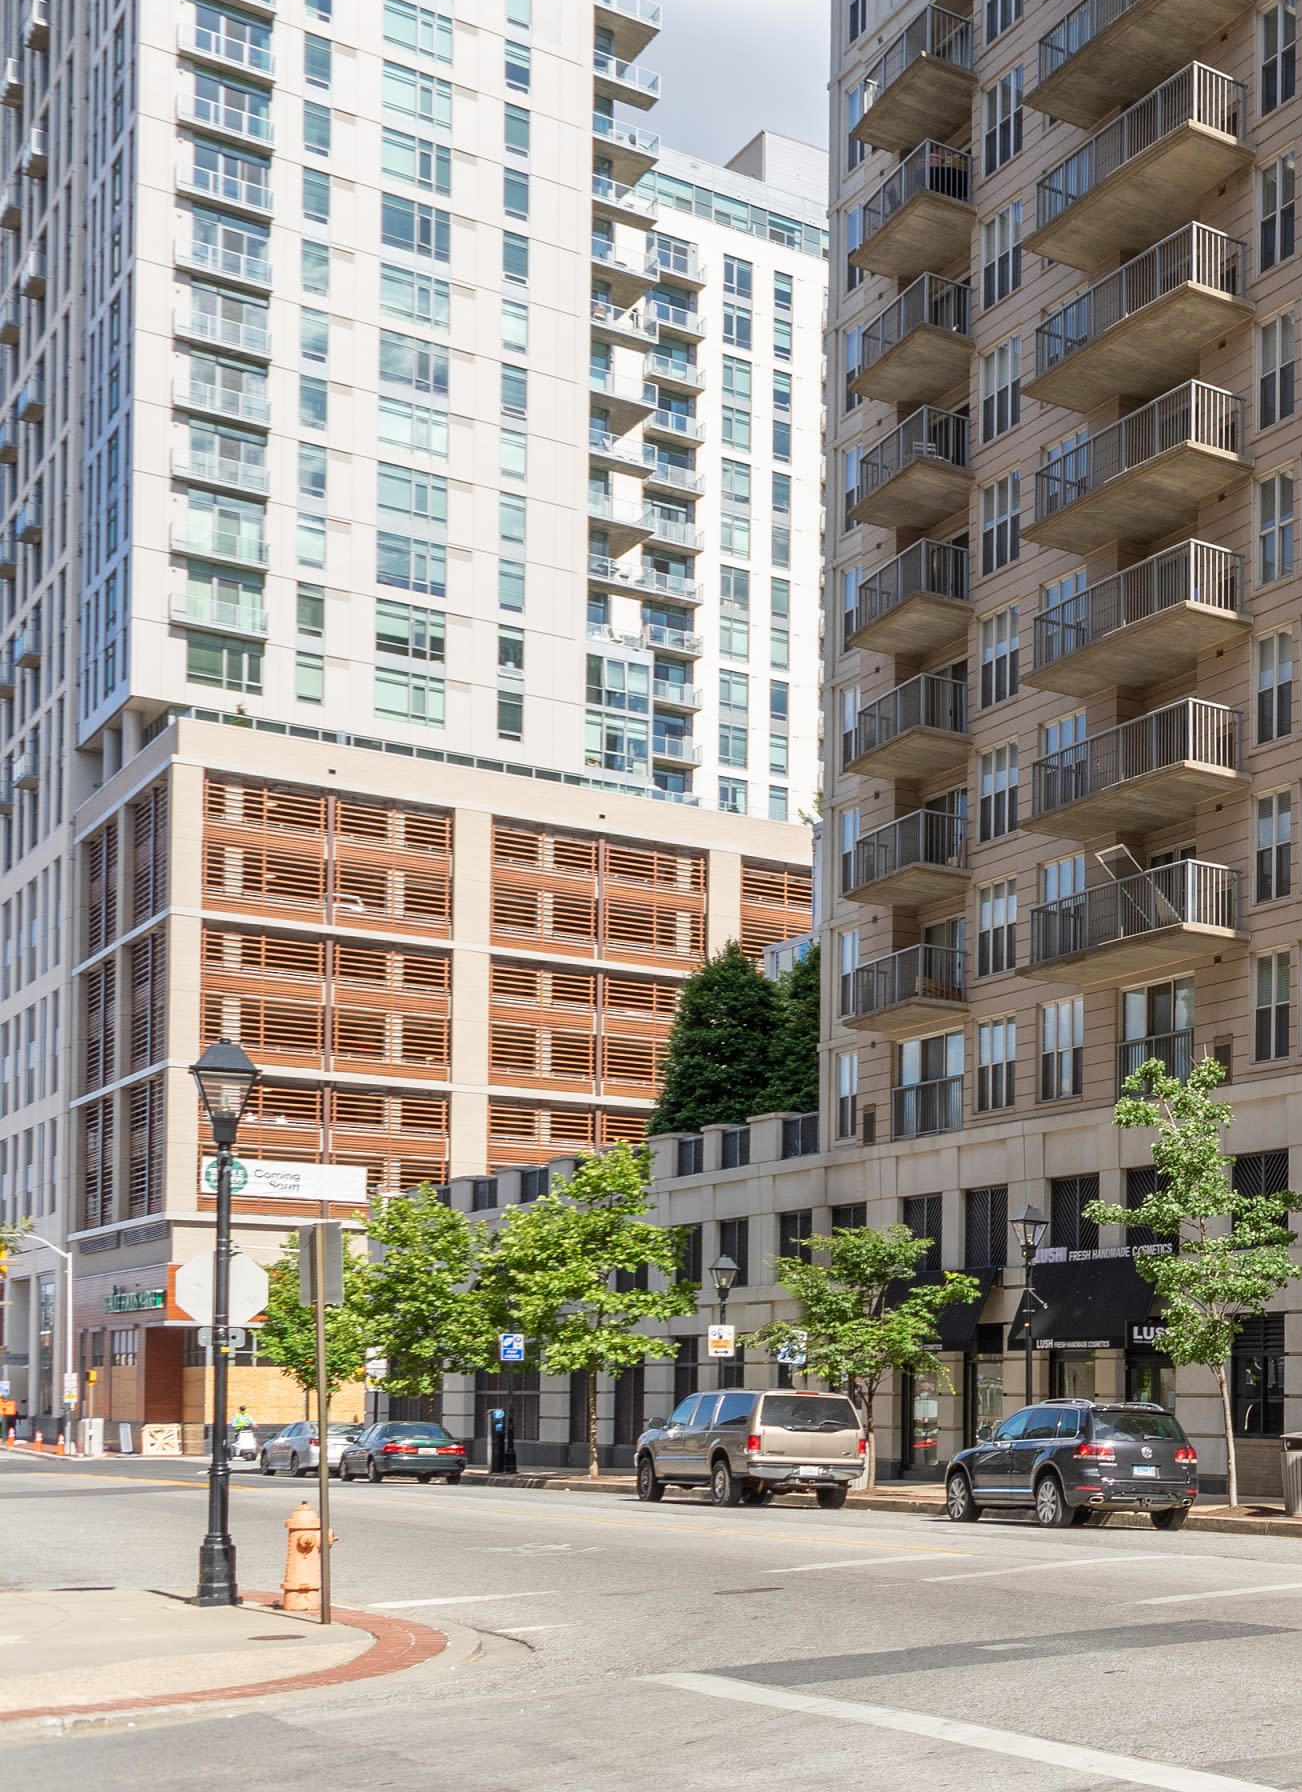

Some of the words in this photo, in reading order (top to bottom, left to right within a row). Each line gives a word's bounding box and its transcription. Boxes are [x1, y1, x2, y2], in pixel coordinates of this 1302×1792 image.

[254, 1168, 300, 1183] Coming
[1069, 1249, 1091, 1261] FRESH
[1092, 1246, 1131, 1259] HANDMADE
[1133, 1326, 1167, 1340] LUS
[1036, 1339, 1053, 1349] LUSH
